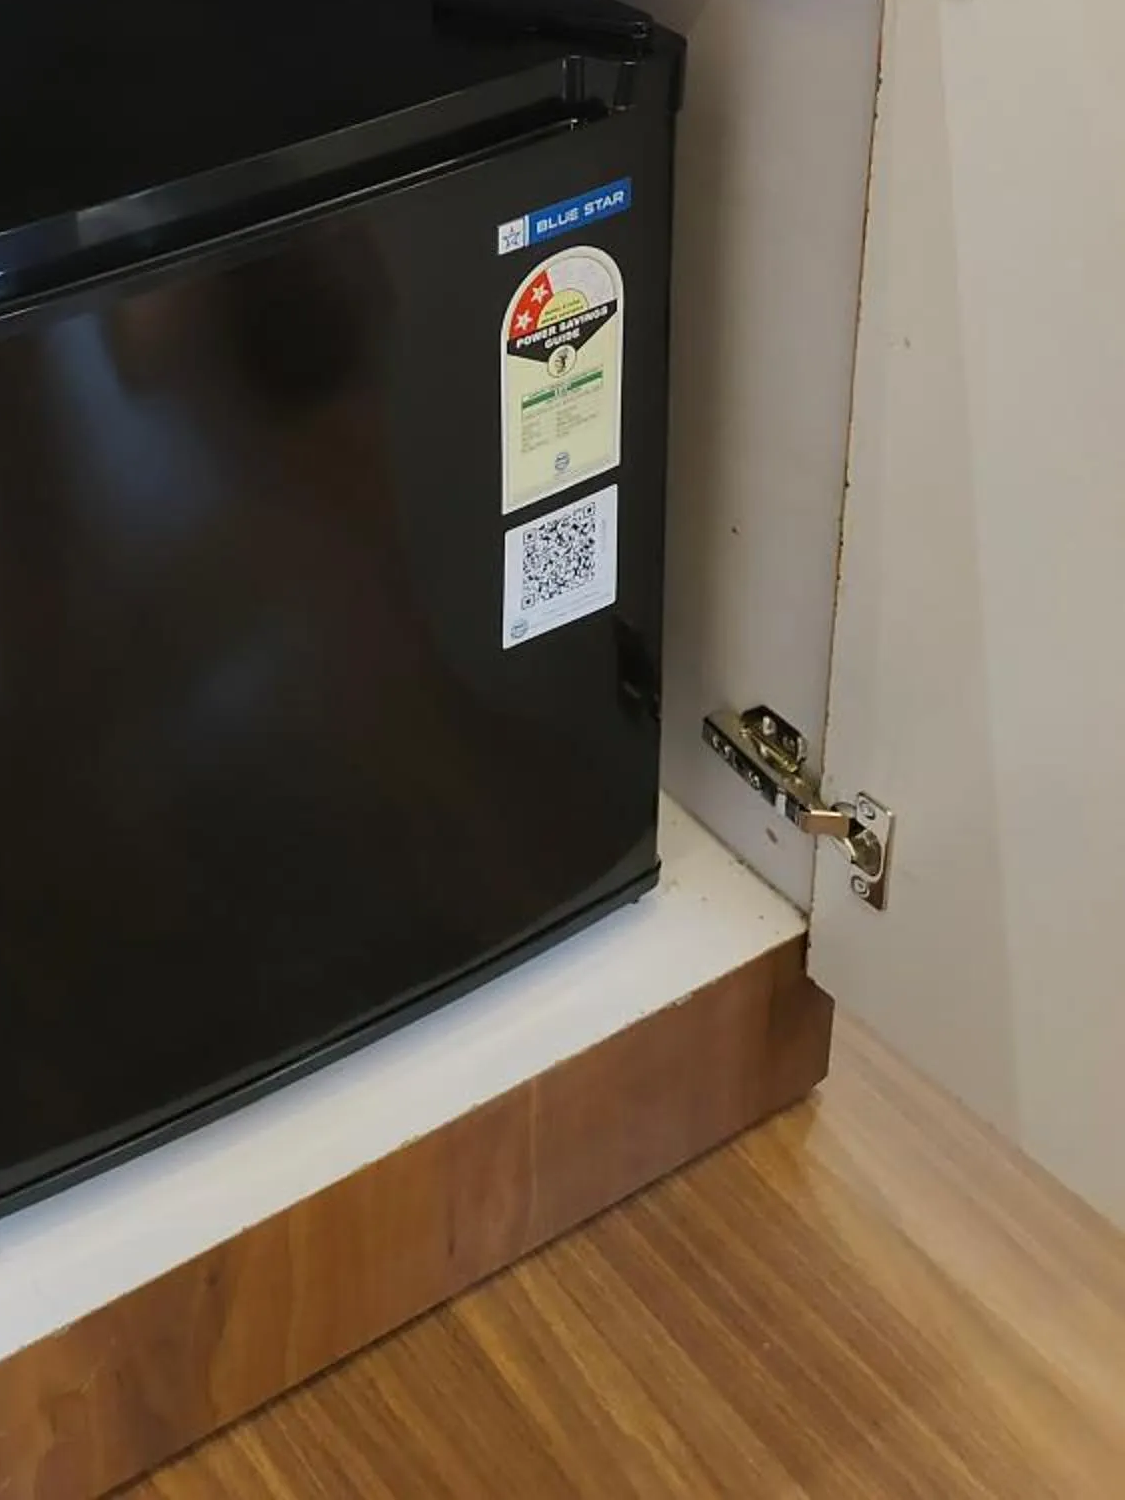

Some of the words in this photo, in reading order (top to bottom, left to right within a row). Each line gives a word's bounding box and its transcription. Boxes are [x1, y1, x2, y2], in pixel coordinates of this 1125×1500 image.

[536, 207, 579, 234] BLUE
[584, 190, 624, 217] STAR
[516, 324, 557, 349] POWER
[559, 305, 609, 332] SAVINGS
[544, 328, 580, 349] GUIDE
